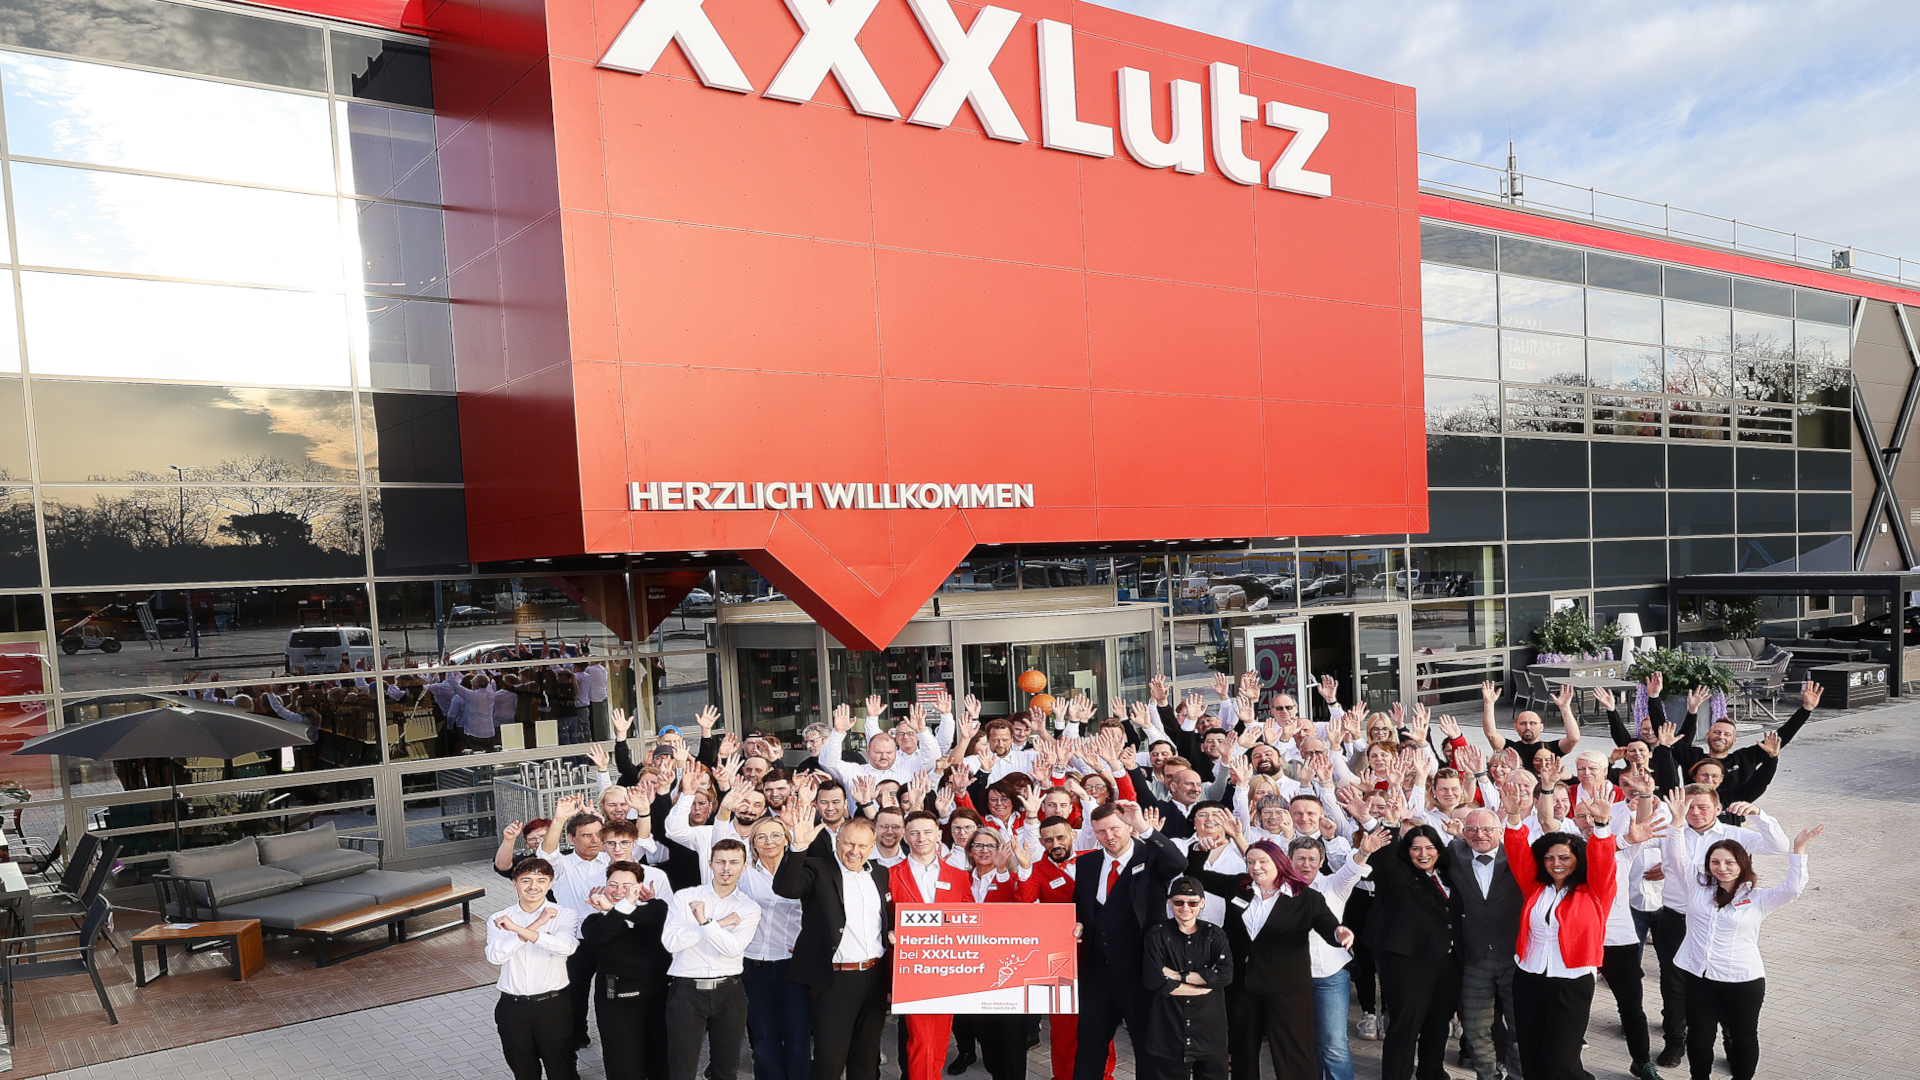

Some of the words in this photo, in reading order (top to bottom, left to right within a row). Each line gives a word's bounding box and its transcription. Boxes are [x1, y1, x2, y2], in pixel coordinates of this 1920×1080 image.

[595, 0, 1333, 199] XXXLutz
[628, 481, 814, 511] HERZLICH
[816, 482, 1035, 511] WILLKOMMEN
[904, 912, 979, 924] XXXLutz
[899, 934, 954, 946] Herzlich
[955, 934, 1040, 946] Willkommen
[899, 949, 919, 960] bei
[921, 949, 980, 960] XXXLutz
[898, 963, 911, 975] in
[913, 963, 986, 976] Rangsdorf
